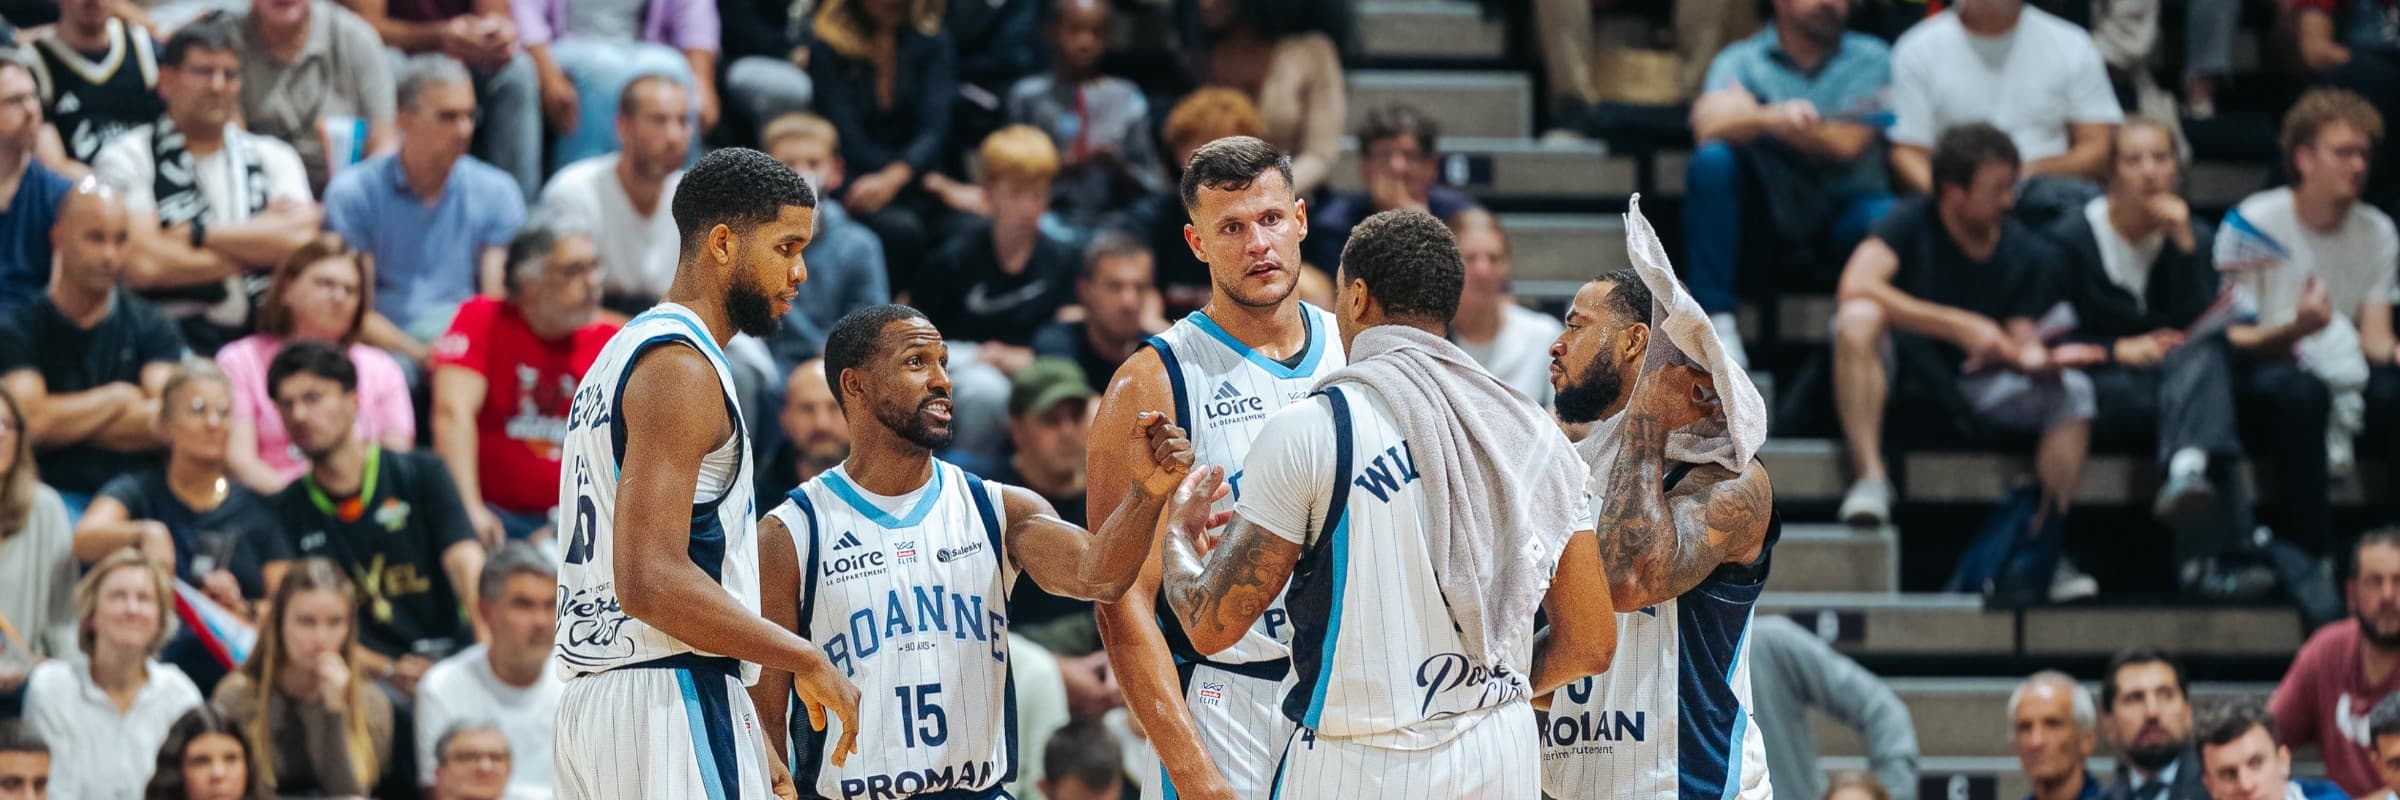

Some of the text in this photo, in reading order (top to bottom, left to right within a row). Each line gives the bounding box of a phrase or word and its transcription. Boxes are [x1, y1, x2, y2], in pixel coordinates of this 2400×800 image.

[1205, 396, 1263, 419] Loire
[823, 551, 884, 577] Loire
[952, 541, 982, 557] Salesky
[823, 585, 1004, 678] ROANNE
[895, 683, 948, 748] 15
[841, 760, 994, 800] PROMAN
